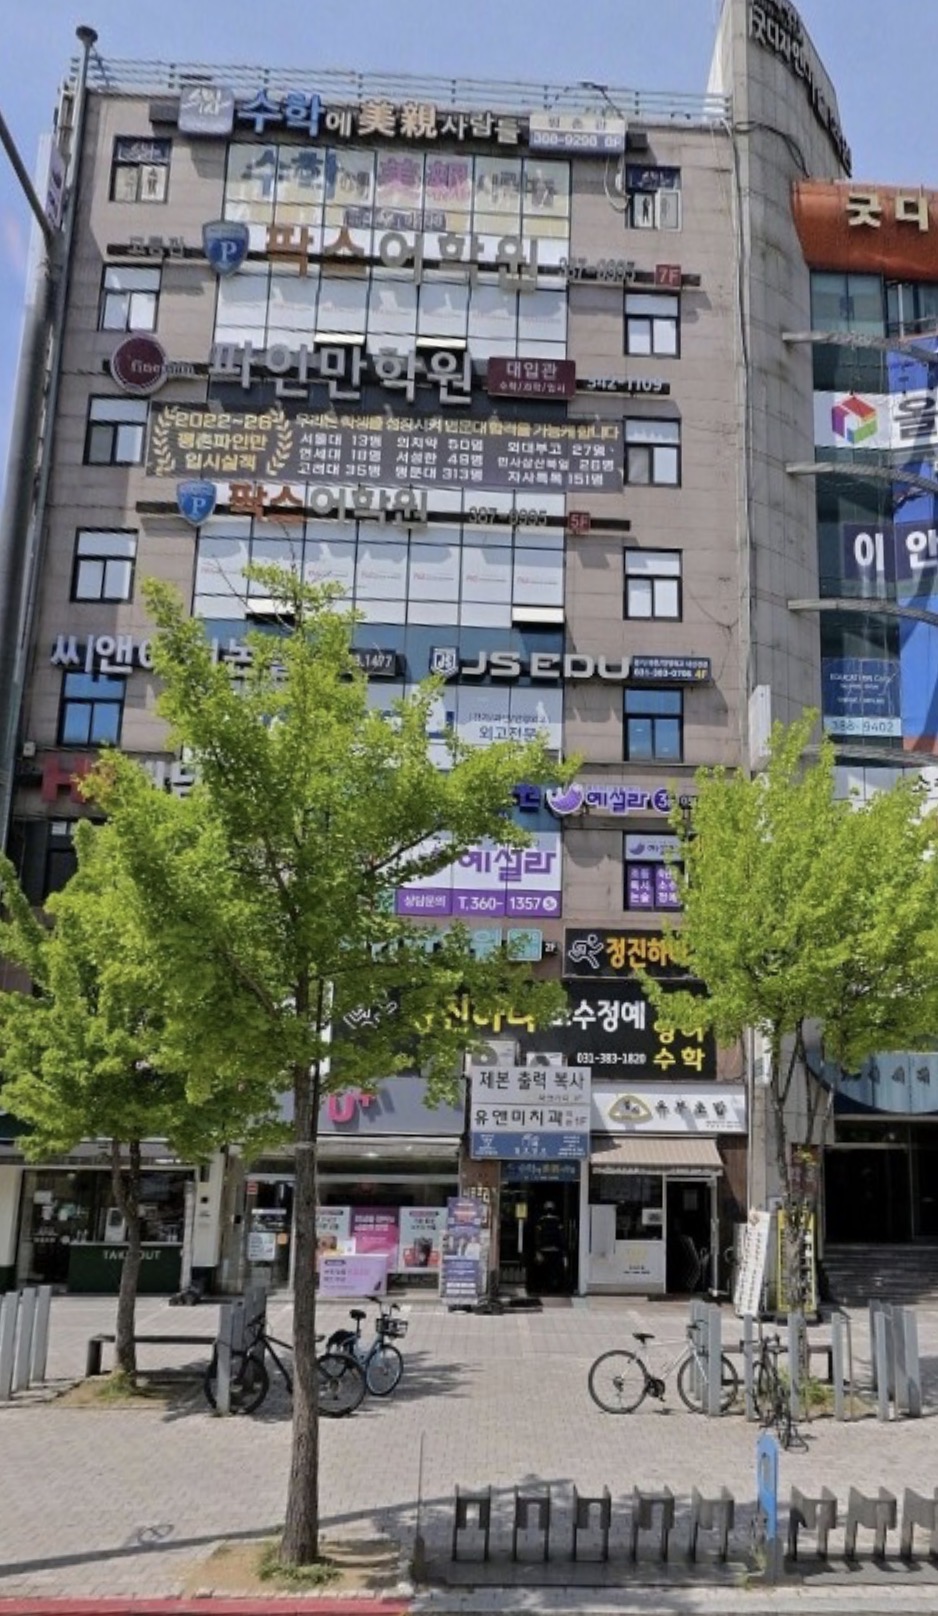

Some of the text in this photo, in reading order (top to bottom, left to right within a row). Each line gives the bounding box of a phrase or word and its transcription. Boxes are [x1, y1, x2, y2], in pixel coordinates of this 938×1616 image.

[660, 266, 680, 286] 7F
[208, 340, 472, 404] 파인만학원
[506, 360, 558, 380] 대입관
[176, 432, 269, 450] 평촌파인만
[300, 432, 382, 448] 서울대 13명
[299, 447, 341, 462] 연세대
[297, 461, 340, 476] 고려대
[653, 1048, 706, 1072] 수학
[480, 1071, 585, 1090] 제본 출력 복사
